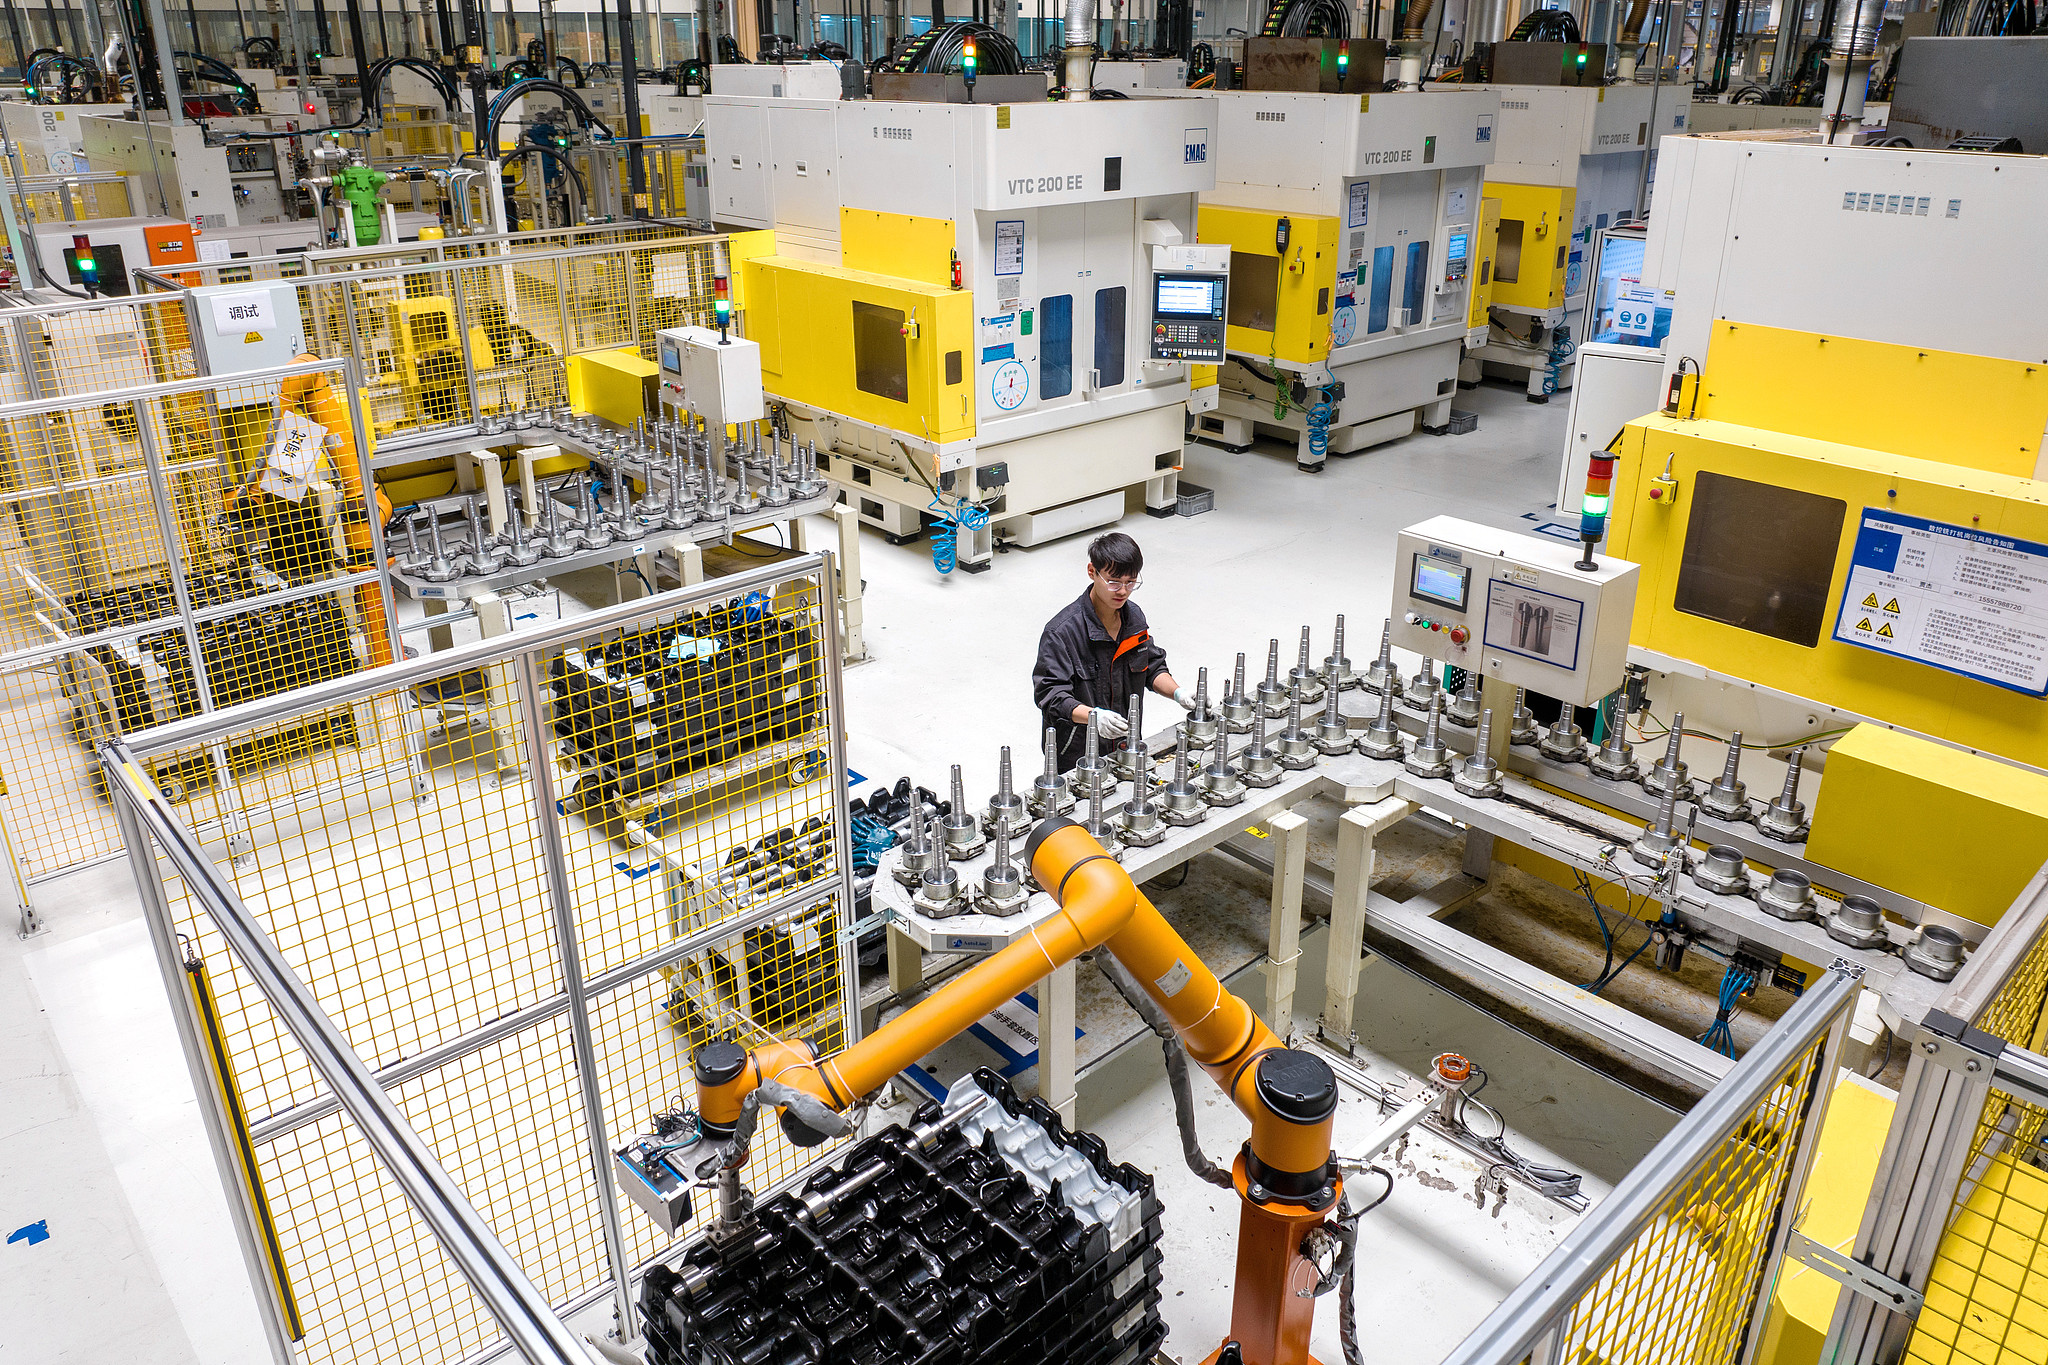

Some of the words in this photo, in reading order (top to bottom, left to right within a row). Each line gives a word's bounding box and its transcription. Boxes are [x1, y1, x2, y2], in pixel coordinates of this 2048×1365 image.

[42, 111, 56, 132] 200
[1477, 126, 1491, 140] EMAG
[1598, 135, 1610, 145] VTC
[1610, 134, 1622, 144] 200
[1622, 133, 1630, 143] EE
[1185, 143, 1206, 162] EMAG
[1365, 152, 1381, 164] VTC
[1383, 151, 1399, 163] 200
[1401, 150, 1412, 161] EE
[1008, 178, 1034, 195] VTC
[1037, 176, 1062, 193] 200
[1066, 175, 1083, 190] EE
[229, 304, 259, 320] 调试
